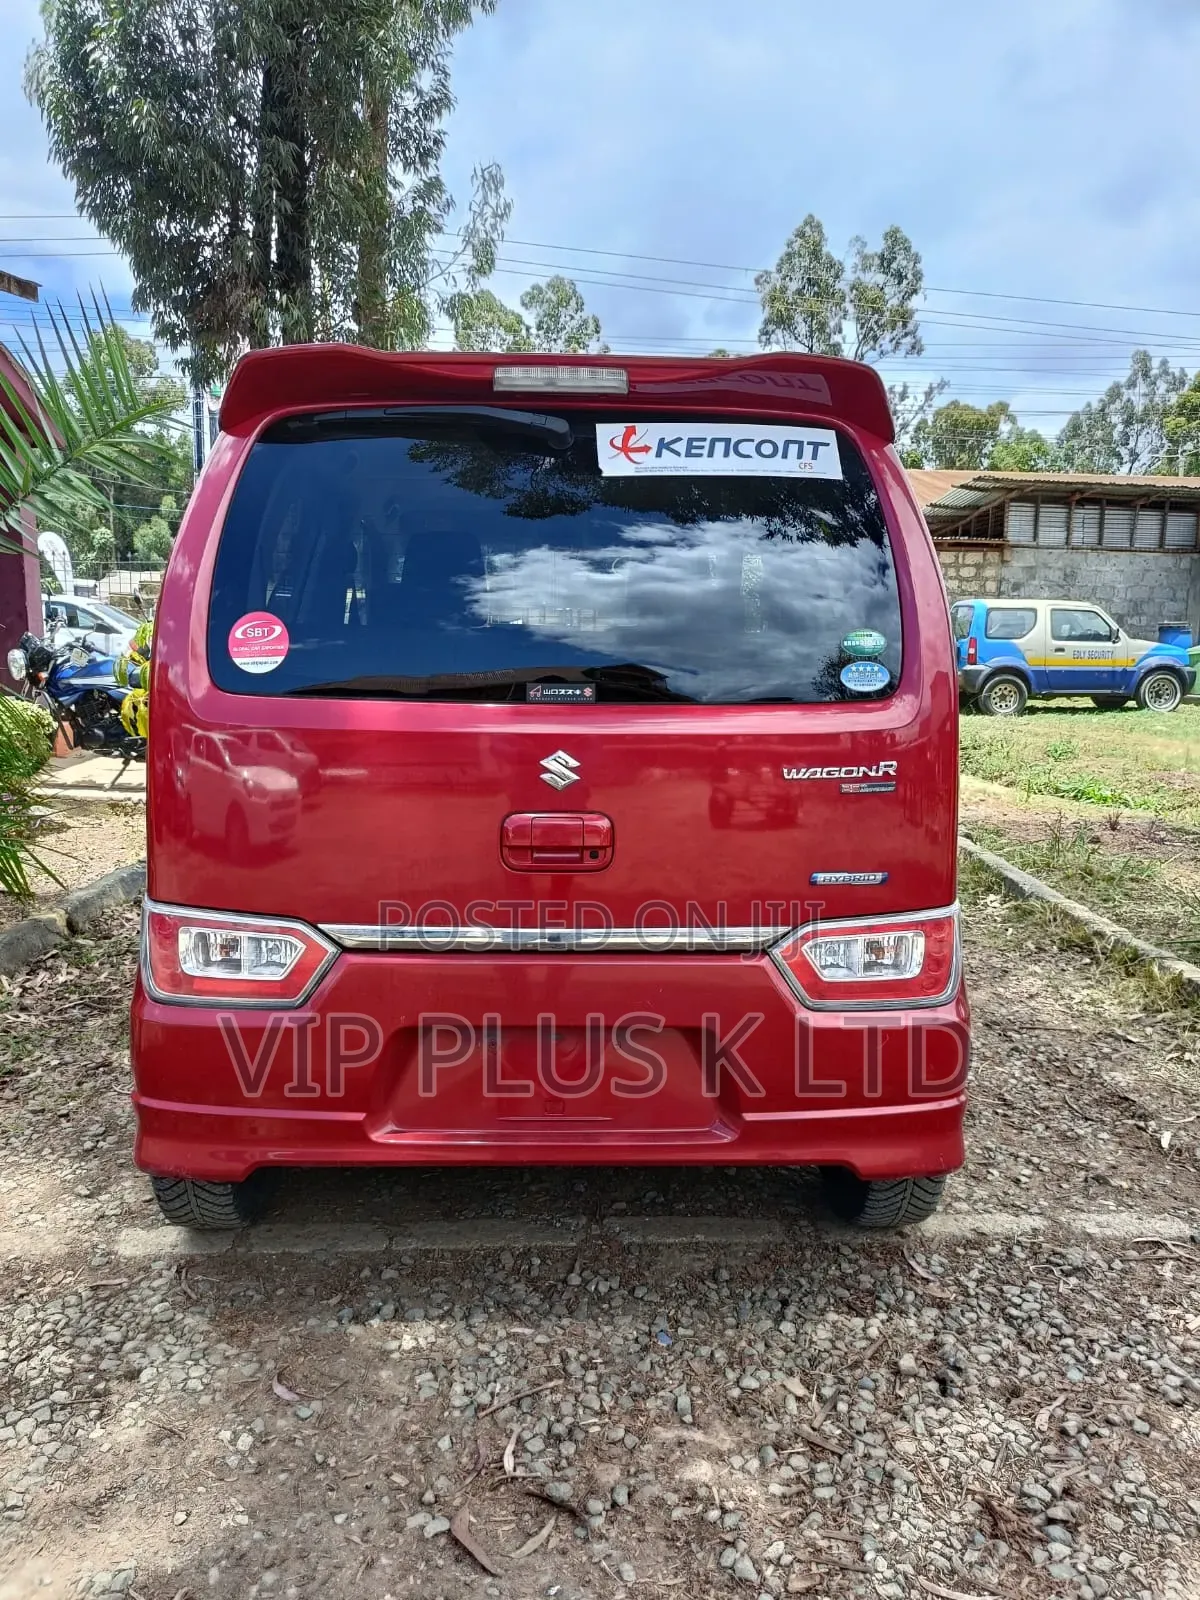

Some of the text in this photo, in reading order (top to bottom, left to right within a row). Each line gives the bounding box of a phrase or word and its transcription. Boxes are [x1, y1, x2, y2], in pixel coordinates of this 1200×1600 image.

[798, 462, 813, 470] CFS
[246, 627, 270, 637] SBT
[1087, 650, 1114, 660] SECURITY
[822, 874, 877, 883] HYBRID
